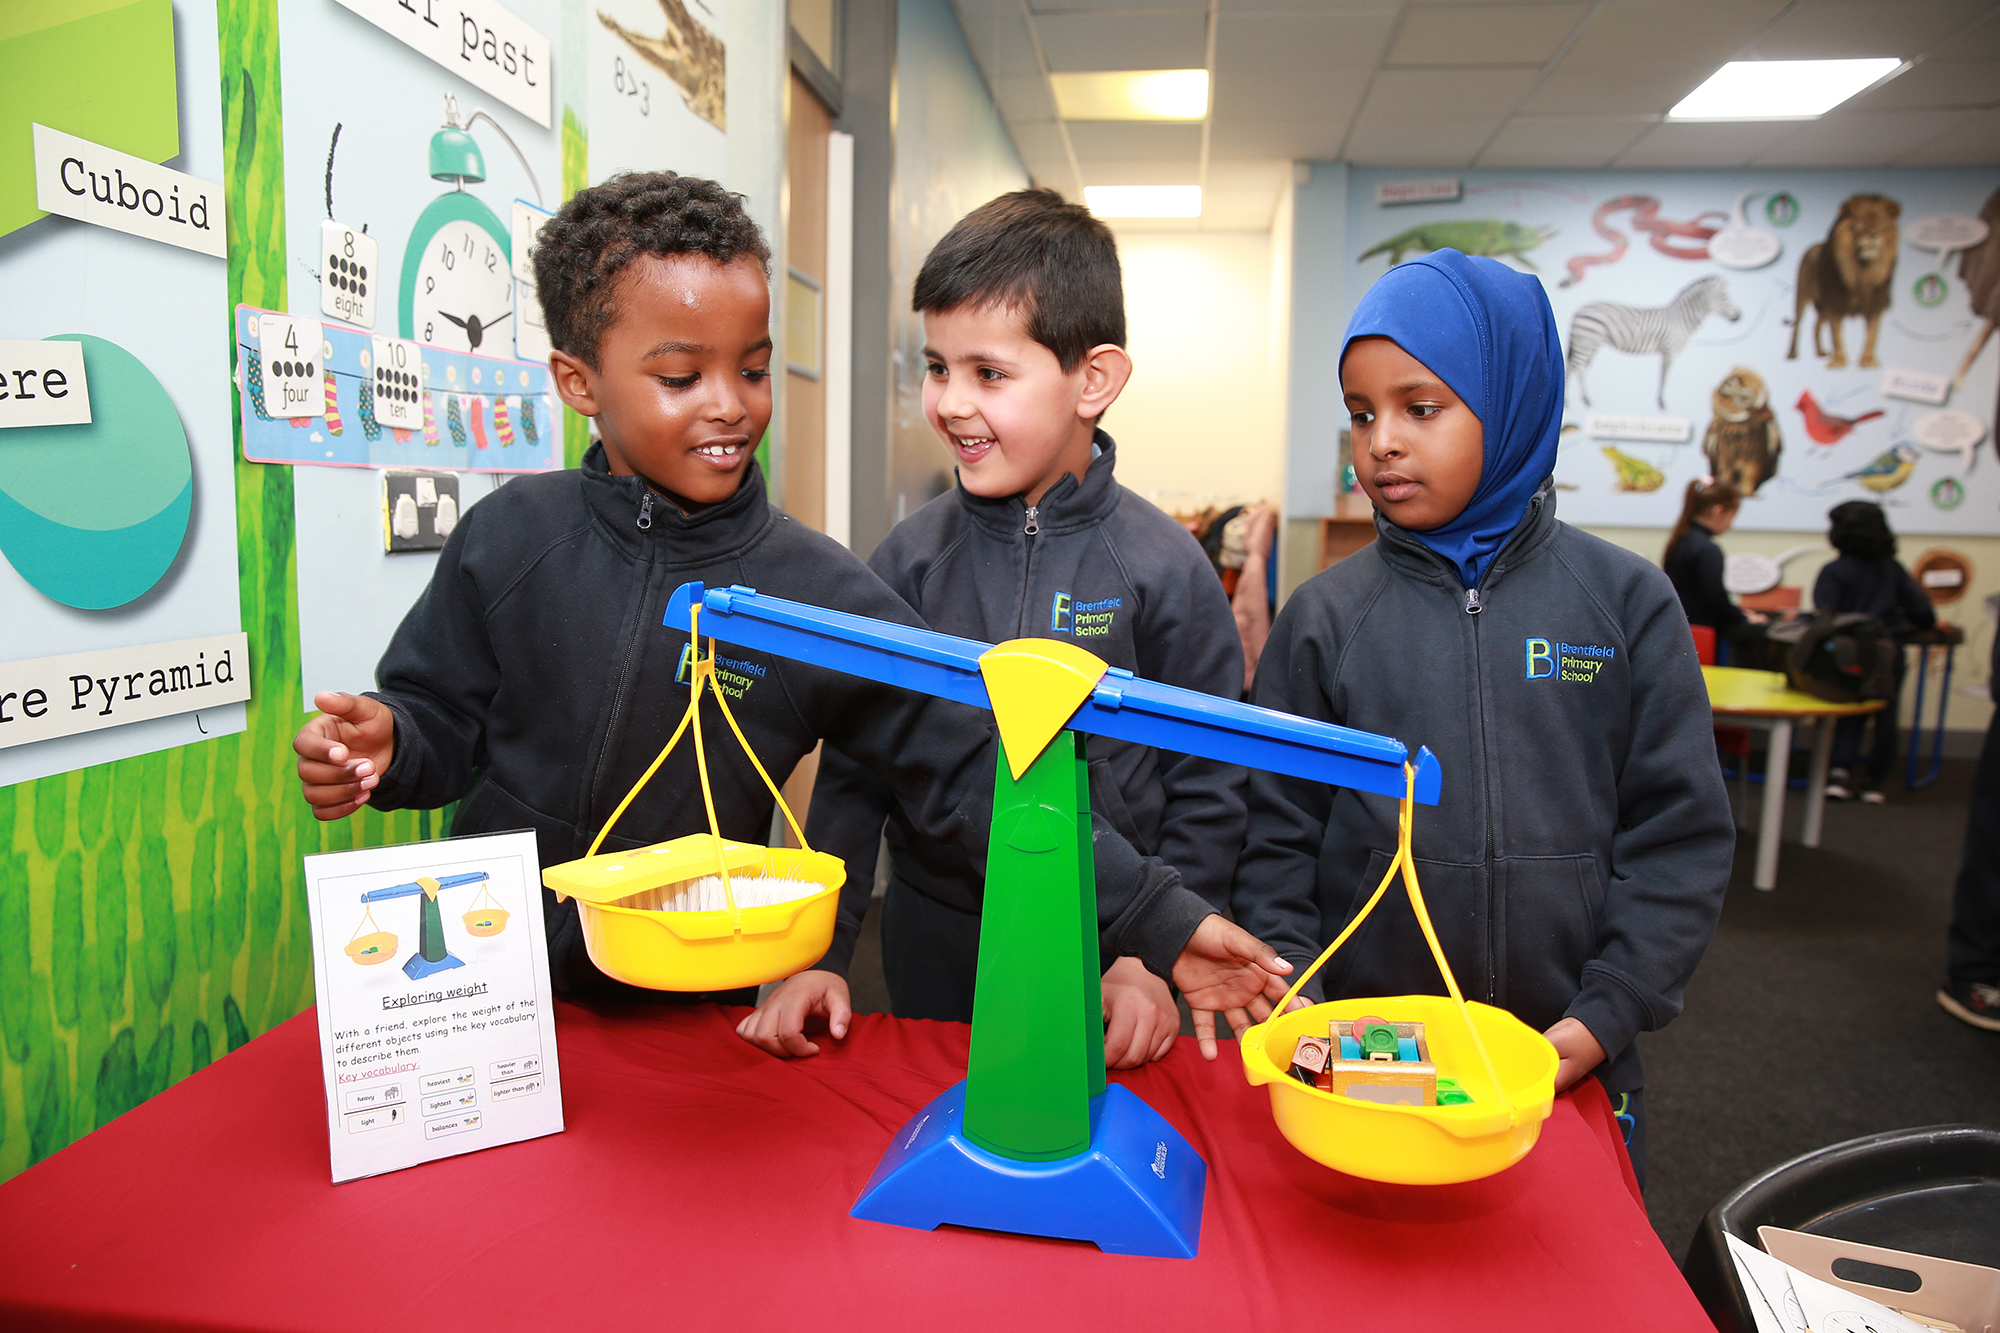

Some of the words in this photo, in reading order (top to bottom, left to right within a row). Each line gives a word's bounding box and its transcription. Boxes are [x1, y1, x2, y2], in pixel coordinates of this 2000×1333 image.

[460, 11, 536, 87] past
[60, 157, 210, 230] Cuboid
[344, 231, 355, 258] 8
[464, 233, 475, 259] 11
[441, 243, 456, 271] 10
[484, 246, 497, 273] 12
[426, 276, 435, 295] 9
[335, 294, 364, 320] eight
[251, 322, 257, 332] 2
[424, 322, 433, 342] 8
[284, 324, 299, 357] 4
[388, 342, 407, 369] 10
[282, 382, 310, 410] four
[390, 403, 407, 419] ten
[1075, 612, 1114, 624] Primary
[1075, 624, 1109, 636] School
[1561, 642, 1615, 658] Brentfield
[714, 653, 767, 677] Brentfield
[1561, 656, 1603, 673] Primary
[69, 649, 234, 716] Pyramid
[1561, 670, 1594, 683] School
[708, 683, 744, 699] Shool
[382, 991, 443, 1008] Exploring
[447, 982, 488, 998] weight
[335, 1029, 359, 1040] With
[375, 1021, 408, 1034] friend,
[412, 1014, 447, 1029] explore
[452, 1010, 468, 1020] the
[472, 1005, 501, 1017] weight
[506, 1001, 516, 1011] of
[520, 999, 535, 1008] the
[335, 1039, 382, 1054] different
[385, 1033, 422, 1047] objects
[425, 1027, 449, 1039] using
[452, 1024, 468, 1034] the
[471, 1021, 487, 1031] key
[490, 1012, 536, 1028] vocabulary
[350, 1052, 392, 1066] describe
[395, 1046, 422, 1057] them.
[338, 1073, 358, 1084] Key
[361, 1061, 421, 1079] vocabulary:
[427, 1078, 451, 1087] heaviest
[357, 1094, 375, 1103] heavy
[493, 1087, 511, 1097] lighter
[512, 1085, 525, 1093] than
[430, 1099, 452, 1109] lightest
[361, 1118, 375, 1126] light
[432, 1122, 458, 1132] balances
